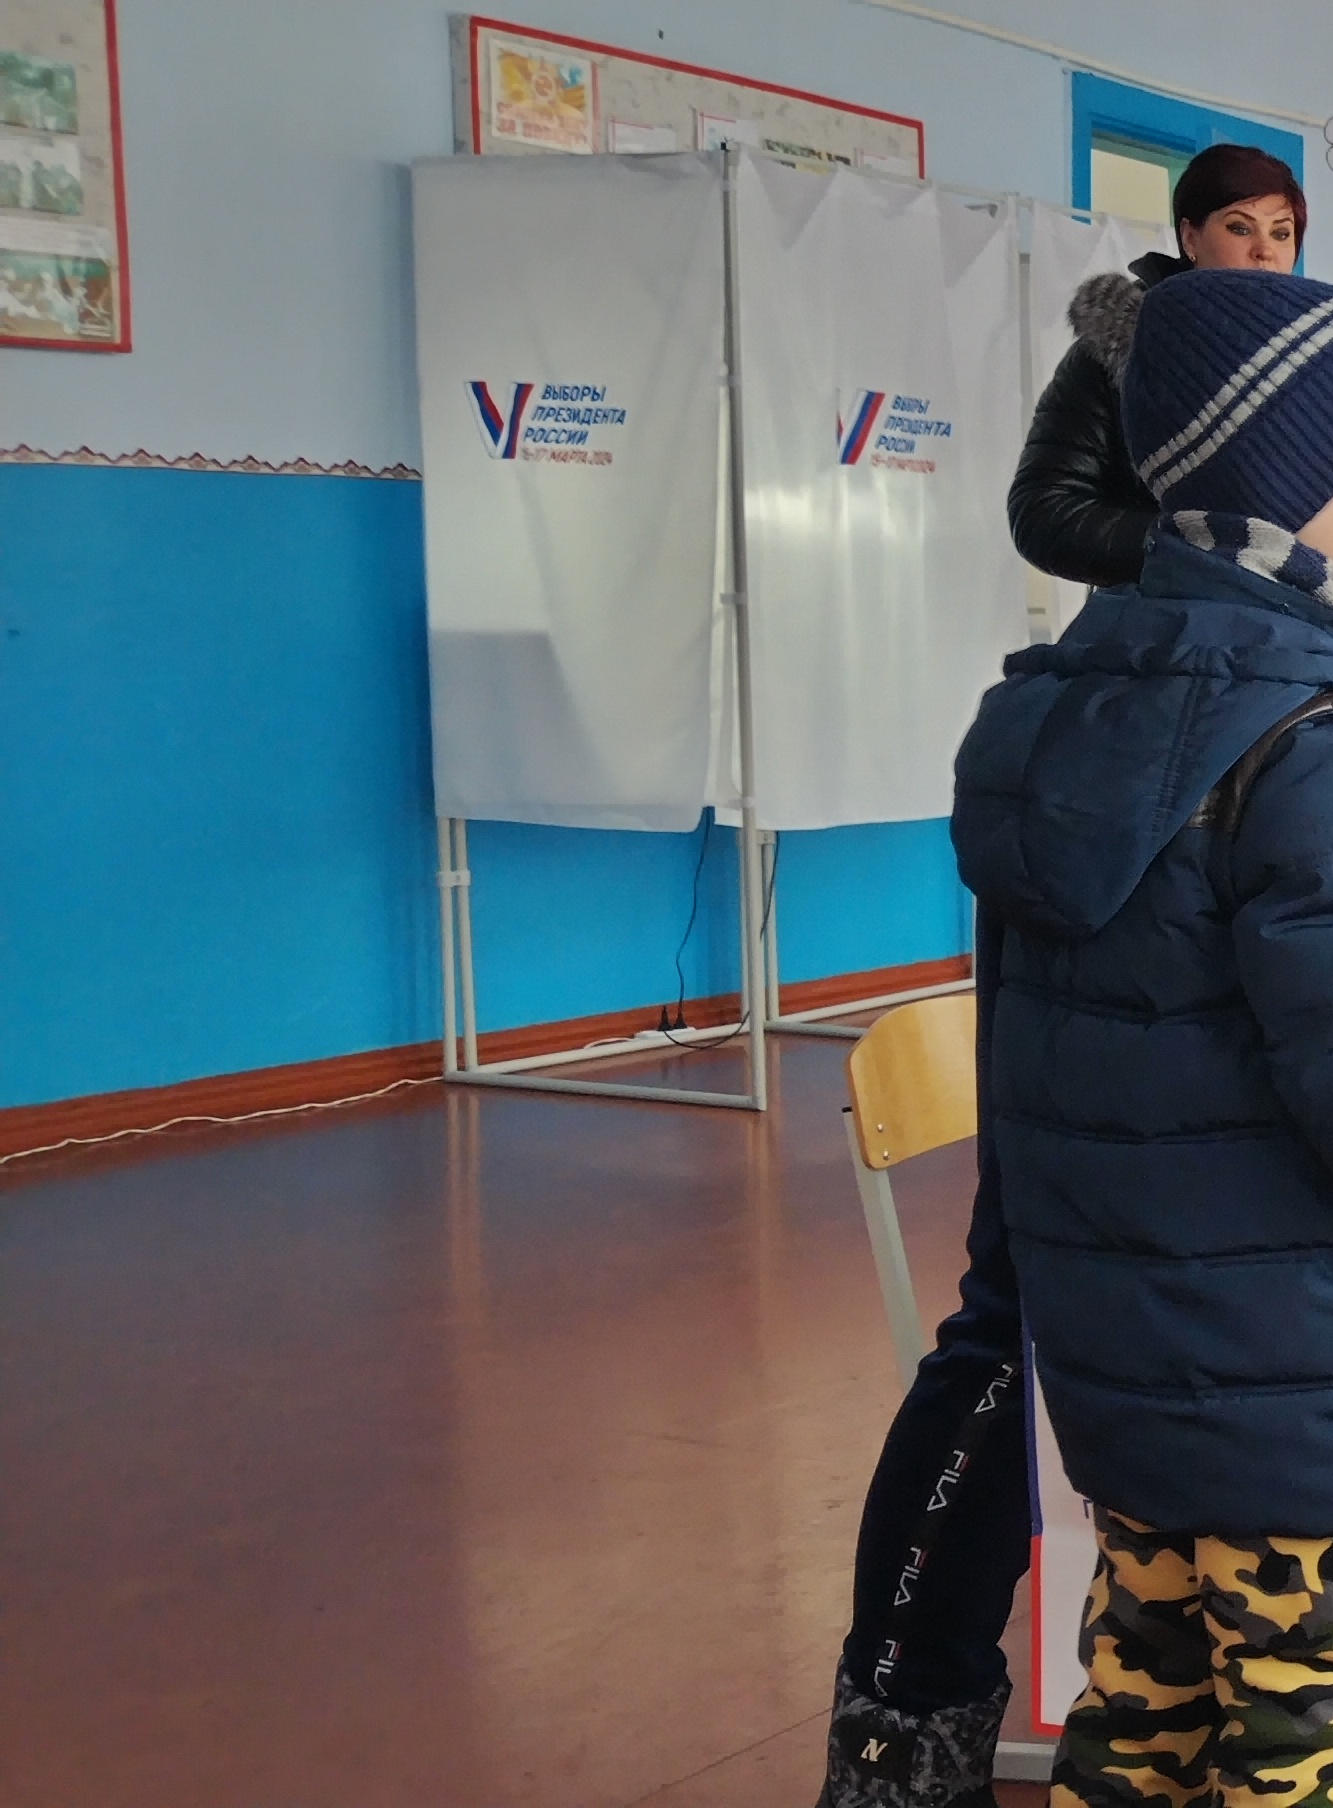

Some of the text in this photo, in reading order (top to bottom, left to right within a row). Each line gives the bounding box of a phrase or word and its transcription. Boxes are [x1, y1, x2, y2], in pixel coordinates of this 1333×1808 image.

[541, 384, 606, 402] ВЫБОРЫ
[532, 406, 627, 425] ПРЕЗИДЕНТА
[524, 427, 589, 445] РОССИИ
[973, 1363, 1015, 1415] FILA
[926, 1449, 969, 1511] FILA
[894, 1547, 926, 1606] FILA
